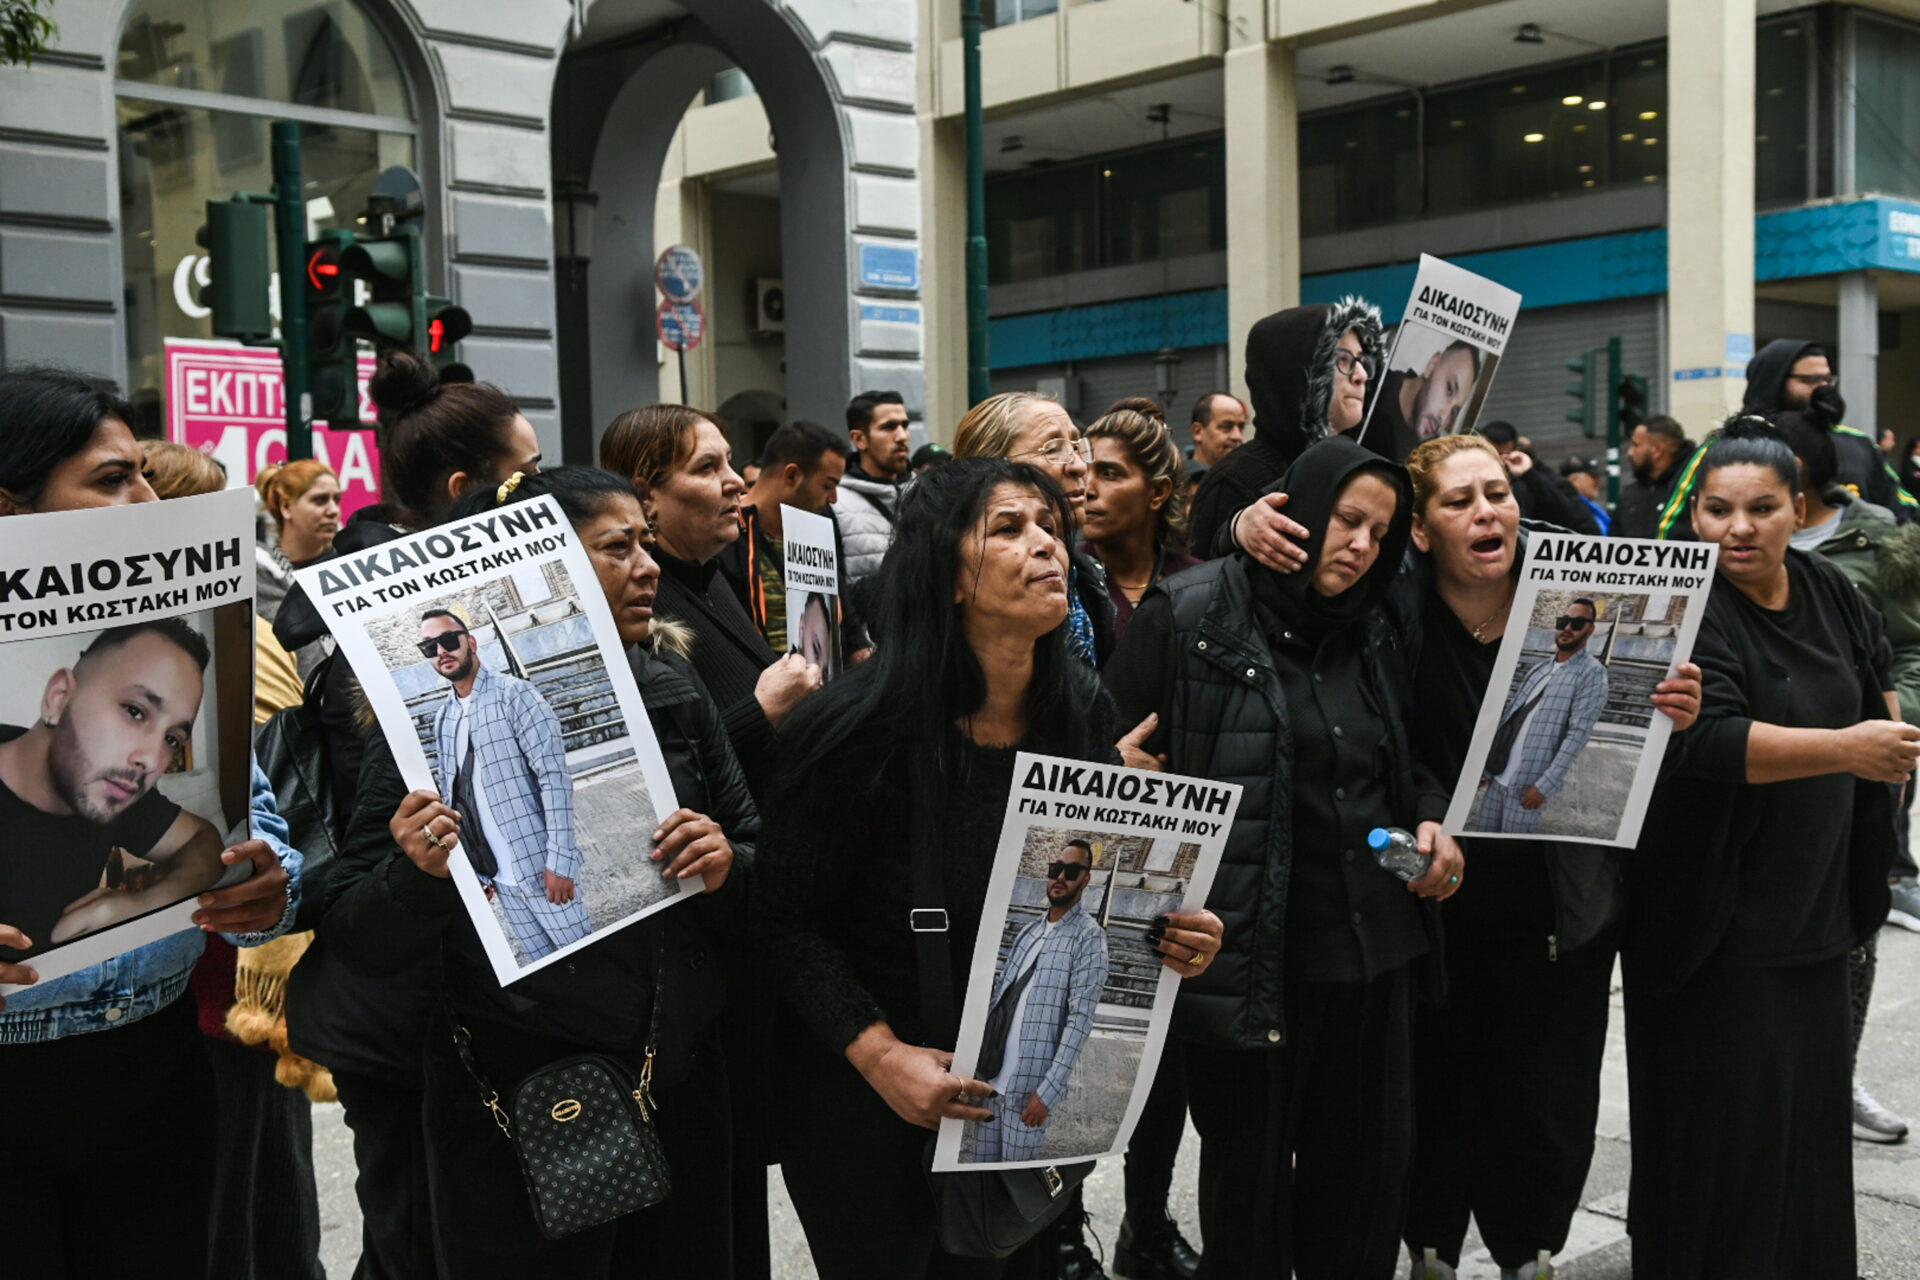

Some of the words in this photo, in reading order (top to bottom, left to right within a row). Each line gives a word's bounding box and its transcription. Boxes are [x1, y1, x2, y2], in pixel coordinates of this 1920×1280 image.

[1413, 307, 1429, 320] ΓΙΑ
[1431, 313, 1448, 328] ΤΟΝ
[1450, 320, 1487, 343] ΚΩΣΤΑΚΗ
[1486, 336, 1501, 349] ΜΟΥ
[1418, 285, 1509, 335] ΔΙΚΑΙΟΣΥΝΗ
[186, 369, 377, 421] ΕΚΠΤΣ
[0, 537, 241, 602] ΚΑΙΟΣΥΝΗ
[318, 502, 558, 596] ΔΙΚΑΙΟΣΥΝΗ
[787, 540, 834, 570] ΔΙΚΑΙΟΣΥΝΗ
[1533, 539, 1710, 570] ΔΙΚΑΙΟΣΥΝΗ
[332, 596, 372, 617] ΓΙΑ
[373, 579, 421, 605] ΤΟΝ
[423, 547, 523, 588] ΚΩΣΤΑΚΗ
[525, 533, 567, 558] ΜΟΥ
[1530, 568, 1555, 581] ΓΙΑ
[1560, 570, 1592, 583] ΤΟΝ
[1596, 571, 1668, 587] ΚΩΣΤΑΚΗ
[1671, 576, 1705, 589] ΜΟΥ
[0, 609, 58, 631] ΤΟΝ
[67, 589, 188, 624] ΚΩΣΤΑΚΗ
[196, 576, 242, 601] ΜΟΥ
[1022, 762, 1232, 815] ΔΙΚΑΙΟΣΥΝΗ
[1019, 798, 1047, 816] ΓΙΑ
[1054, 802, 1090, 820] ΤΟΝ
[1093, 807, 1179, 831] ΚΩΣΤΑΚΗ
[1181, 819, 1222, 838] ΜΟΥ
